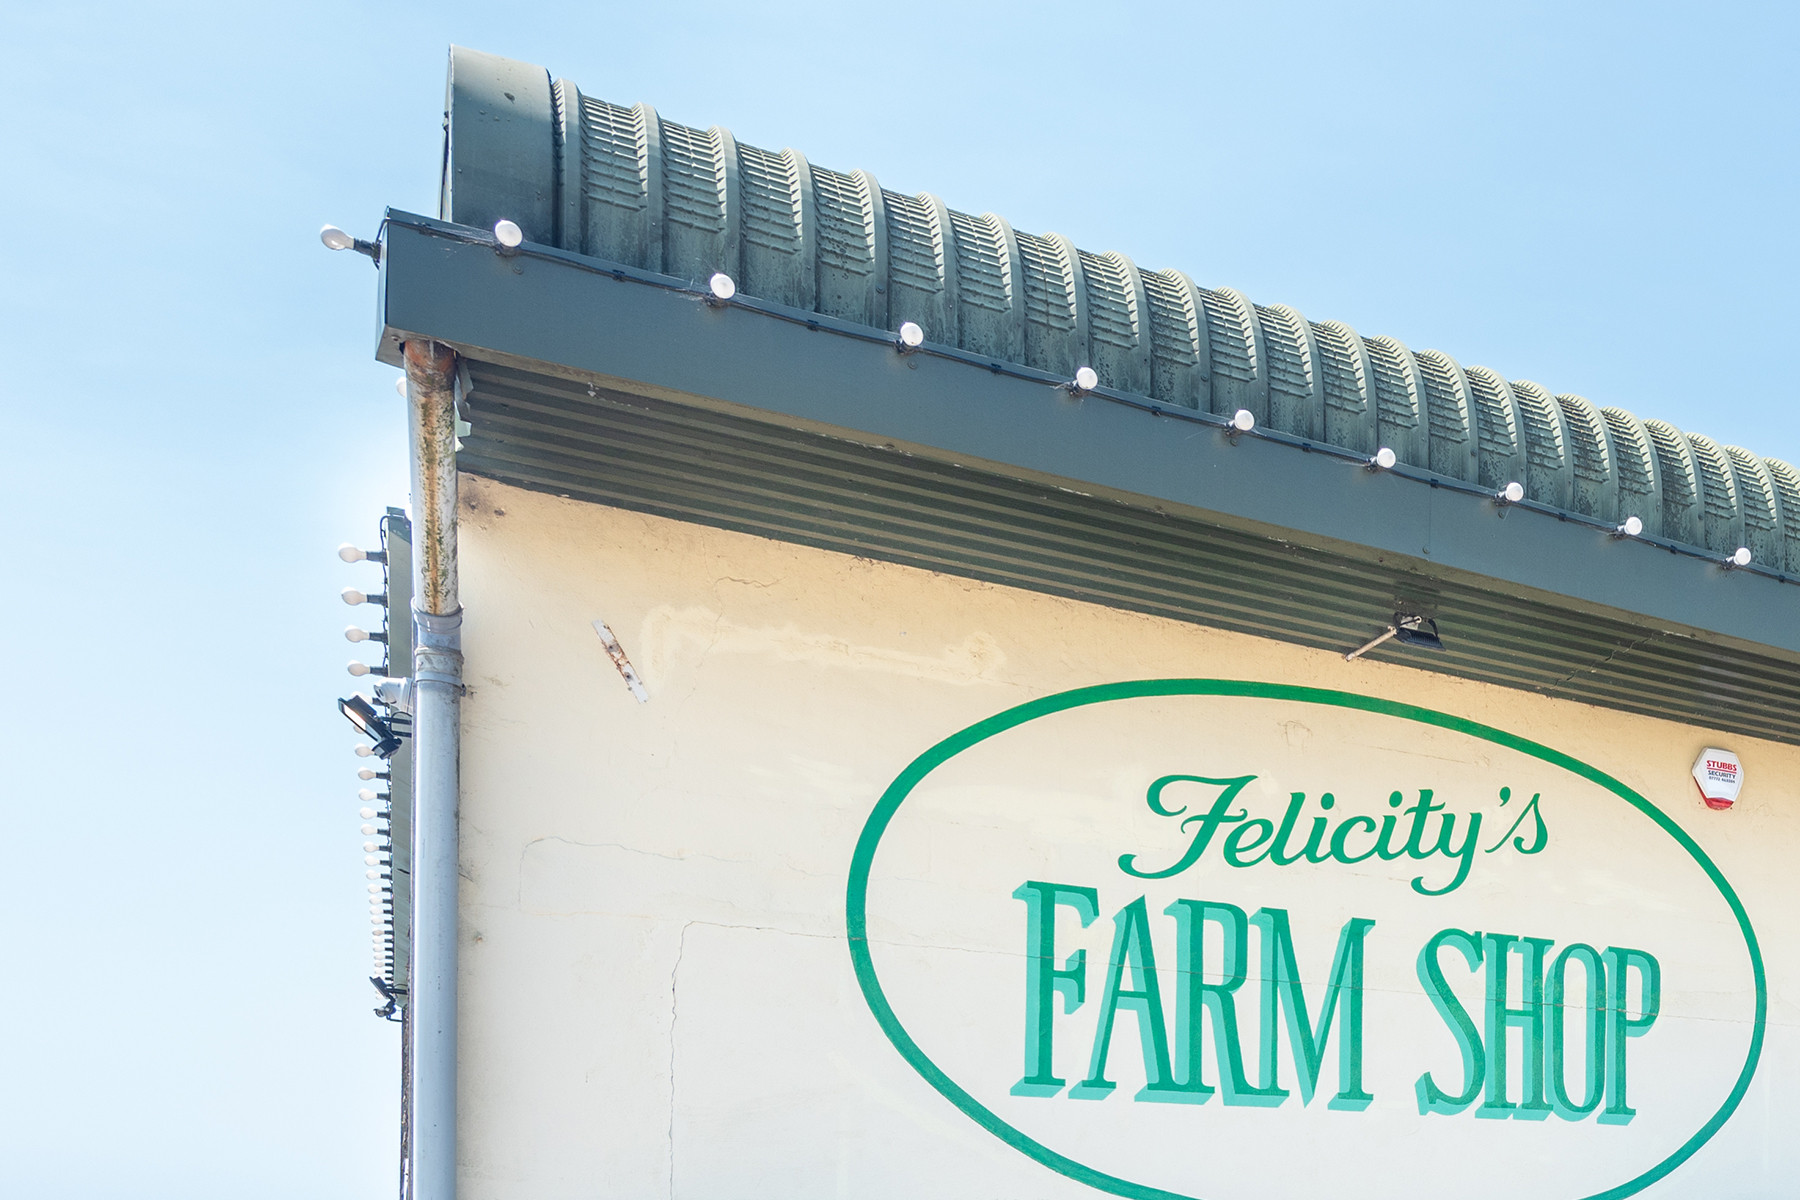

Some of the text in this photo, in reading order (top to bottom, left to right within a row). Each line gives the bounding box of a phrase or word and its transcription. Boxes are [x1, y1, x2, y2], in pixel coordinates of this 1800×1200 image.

[1706, 760, 1737, 771] STUBBS
[1708, 770, 1735, 779] SECURITY
[1118, 773, 1549, 896] Felicity's
[1010, 880, 1662, 1126] FARM SHOP
